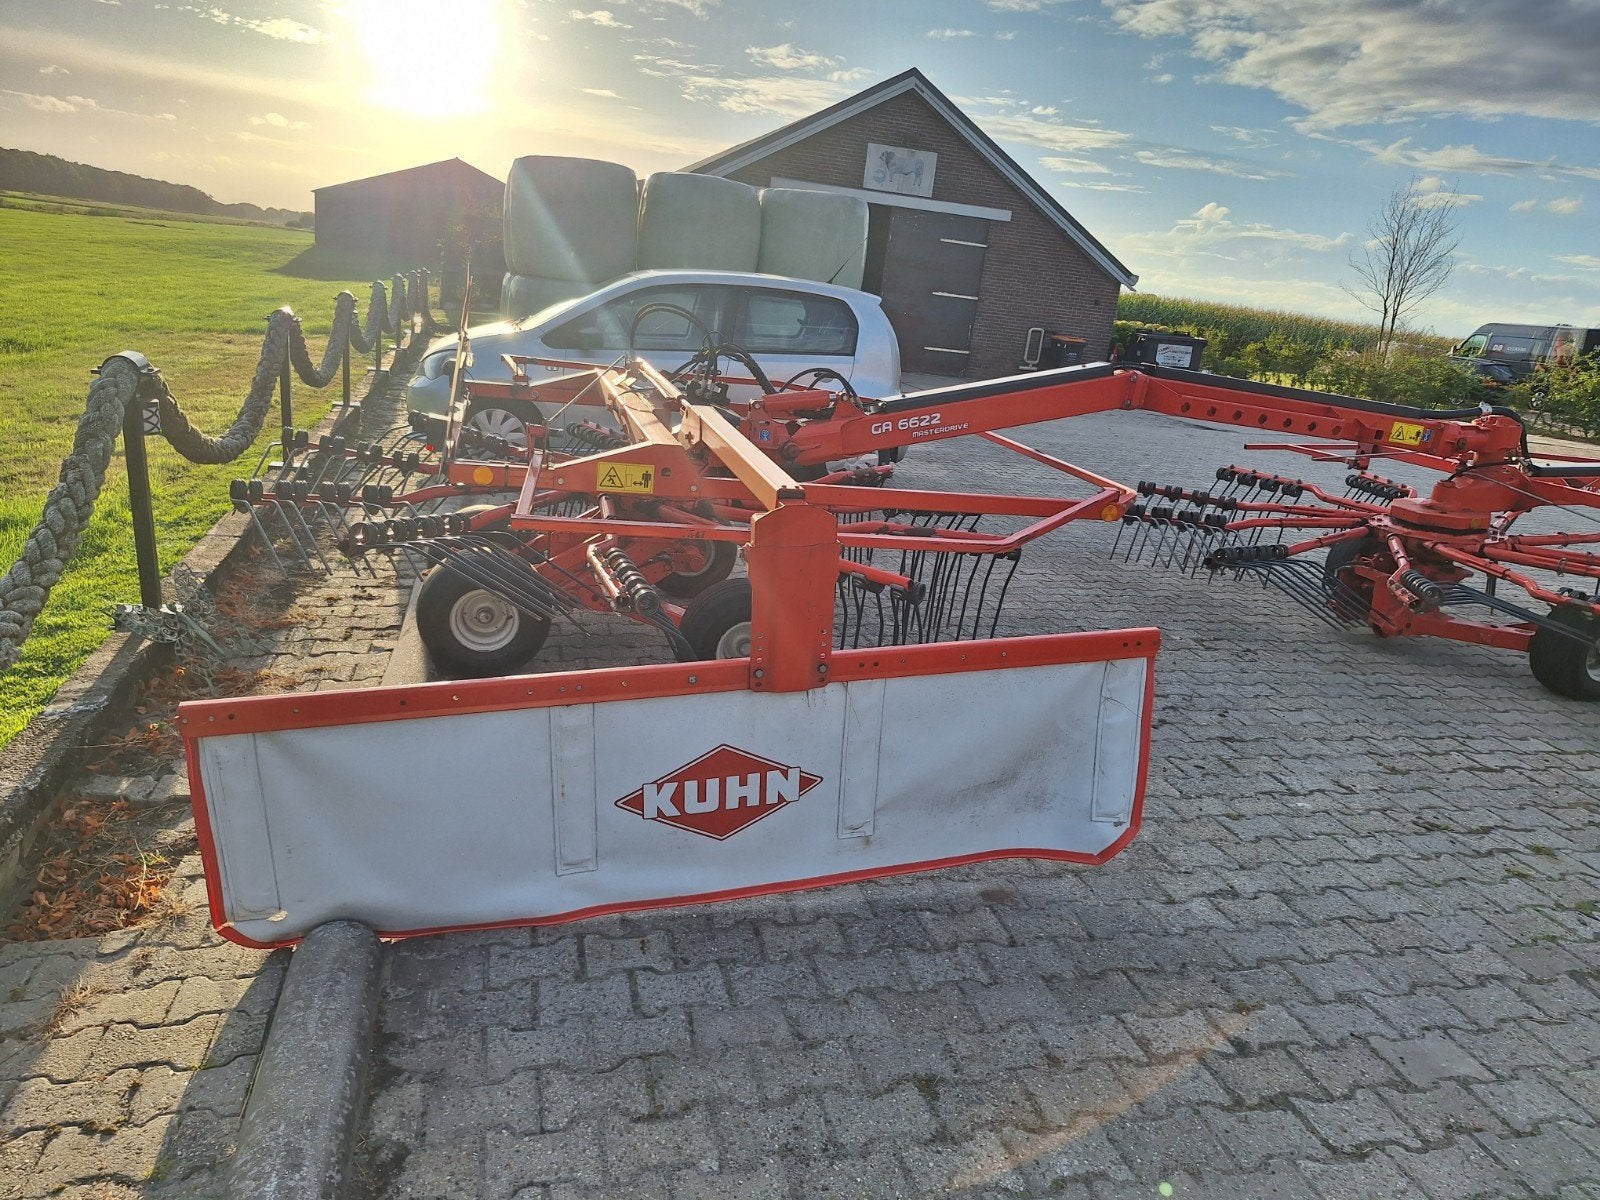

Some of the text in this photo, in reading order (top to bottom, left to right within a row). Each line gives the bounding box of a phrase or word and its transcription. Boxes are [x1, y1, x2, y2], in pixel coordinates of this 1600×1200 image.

[871, 412, 941, 435] GA 6622
[912, 422, 969, 438] MASTERDRIVE
[642, 766, 801, 819] KUHN
